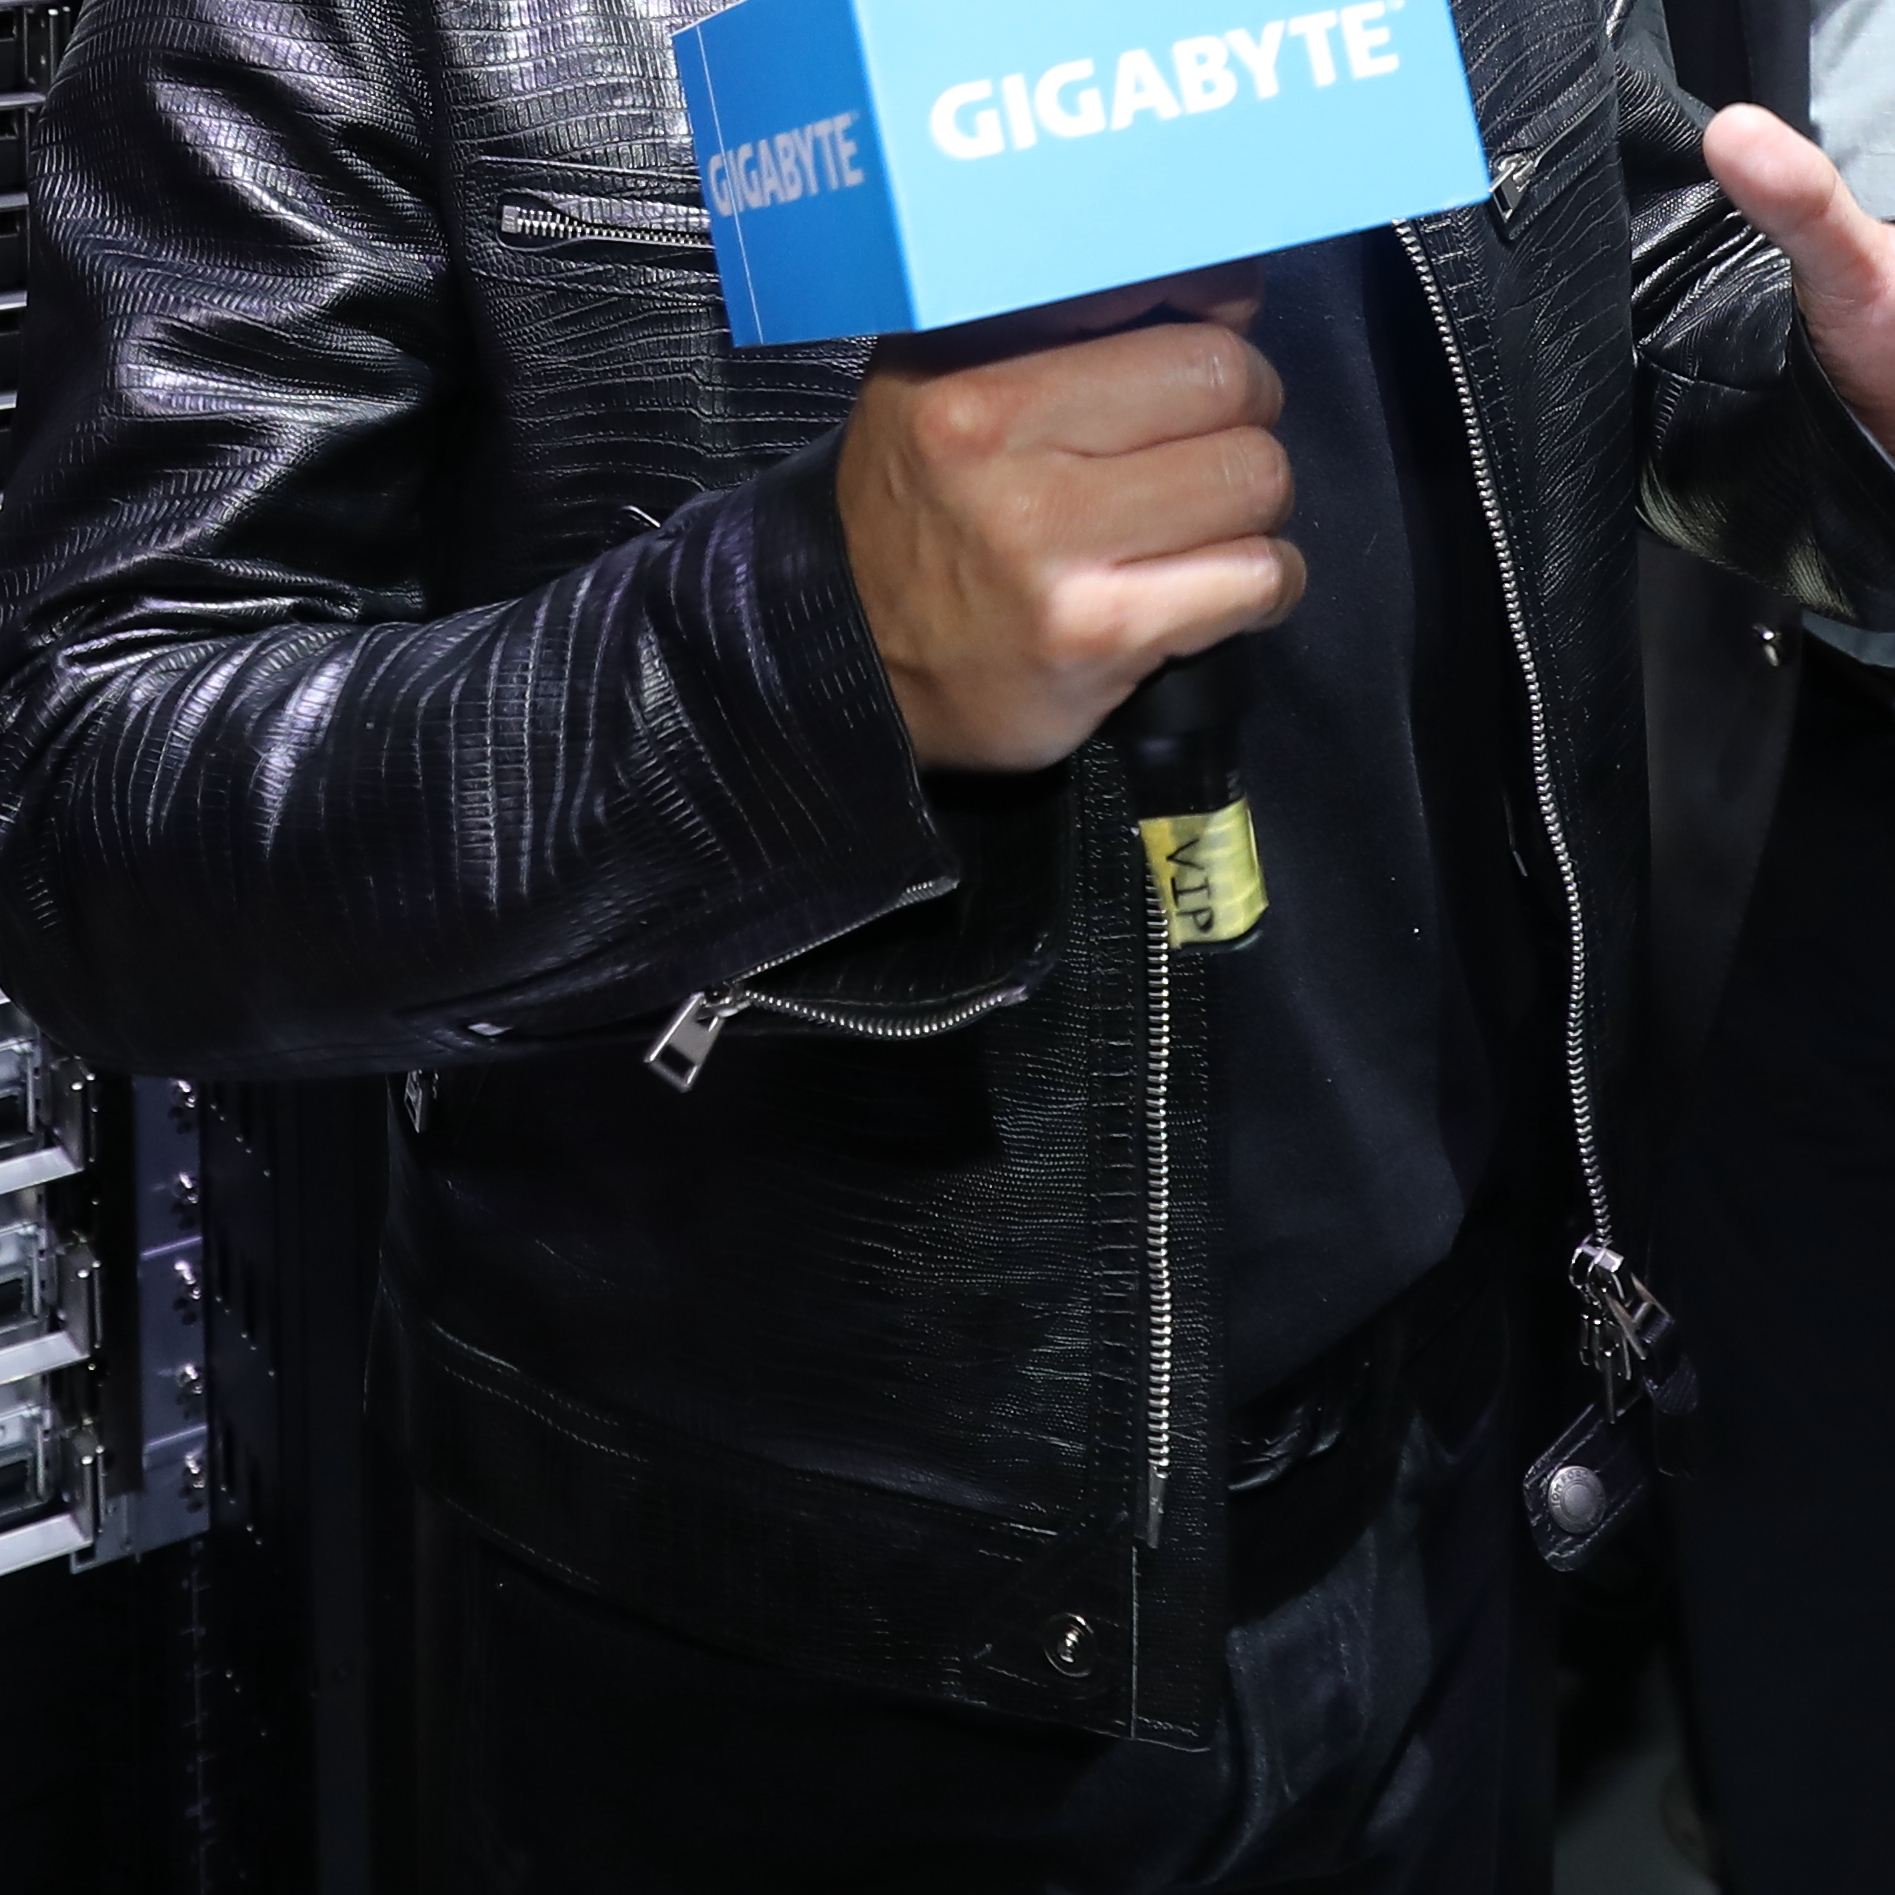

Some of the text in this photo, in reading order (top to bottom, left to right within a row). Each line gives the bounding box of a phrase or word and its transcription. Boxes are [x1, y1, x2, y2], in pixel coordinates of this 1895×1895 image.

[930, 0, 1401, 161] GIGABYTE
[708, 113, 864, 217] GIGABYTE
[1166, 836, 1214, 934] VIP
